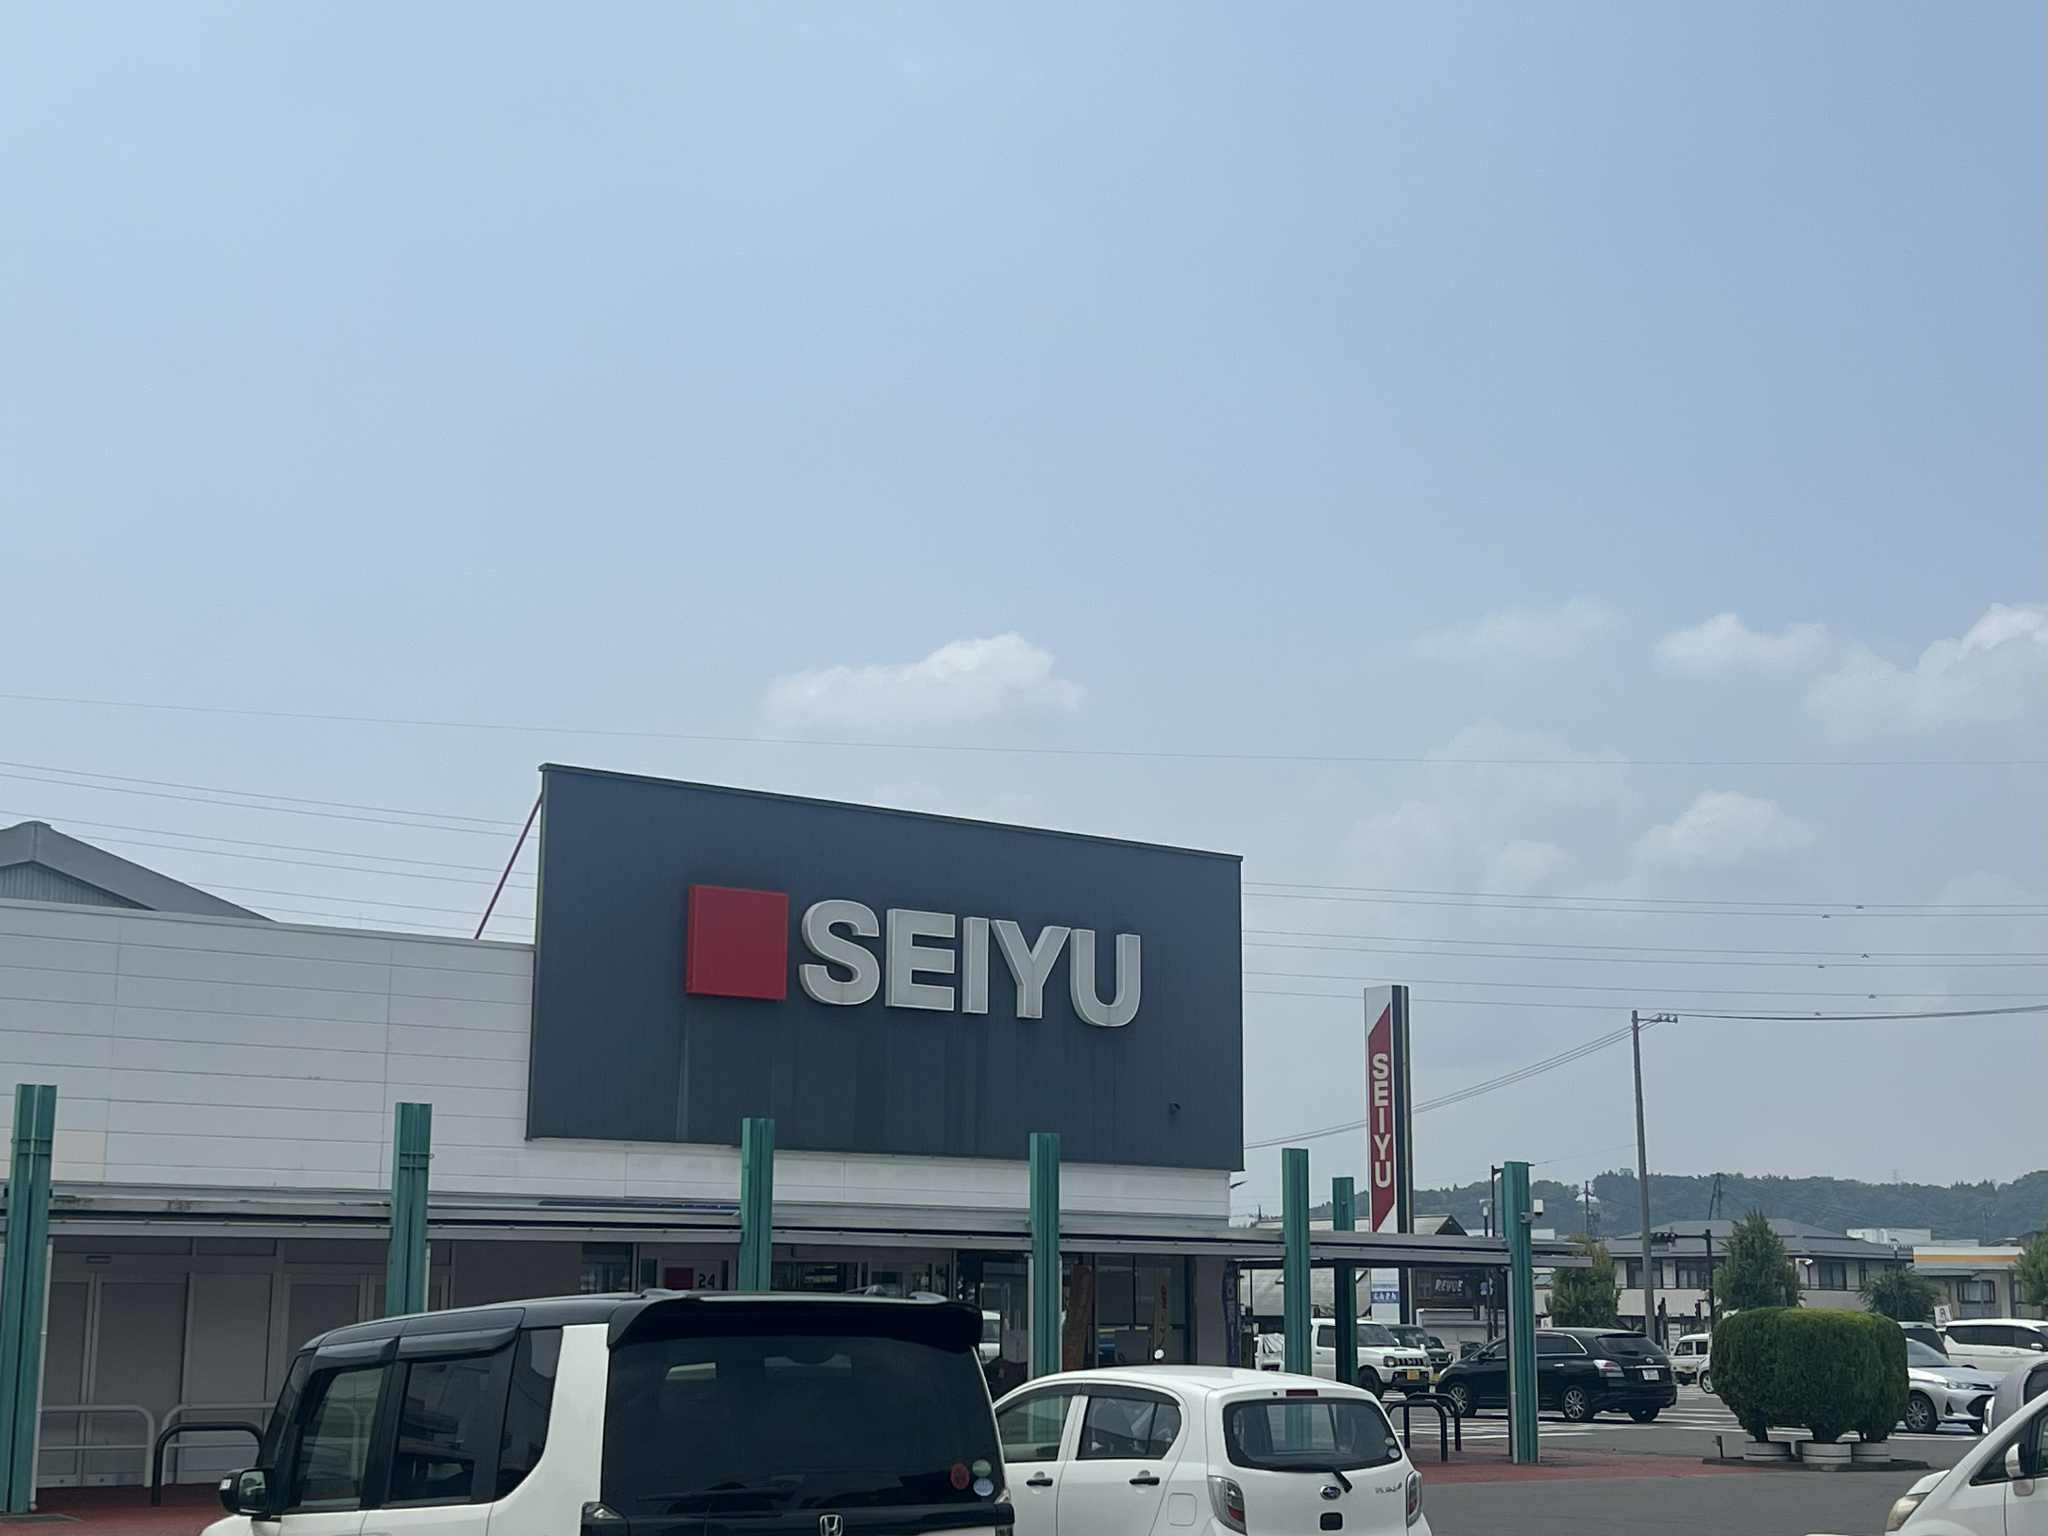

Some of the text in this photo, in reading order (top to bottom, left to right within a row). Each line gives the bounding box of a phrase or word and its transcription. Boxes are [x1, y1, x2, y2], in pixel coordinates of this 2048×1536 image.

[799, 898, 1141, 1028] SEIYU
[1371, 1052, 1391, 1189] SEIYU
[698, 1273, 716, 1289] 24
